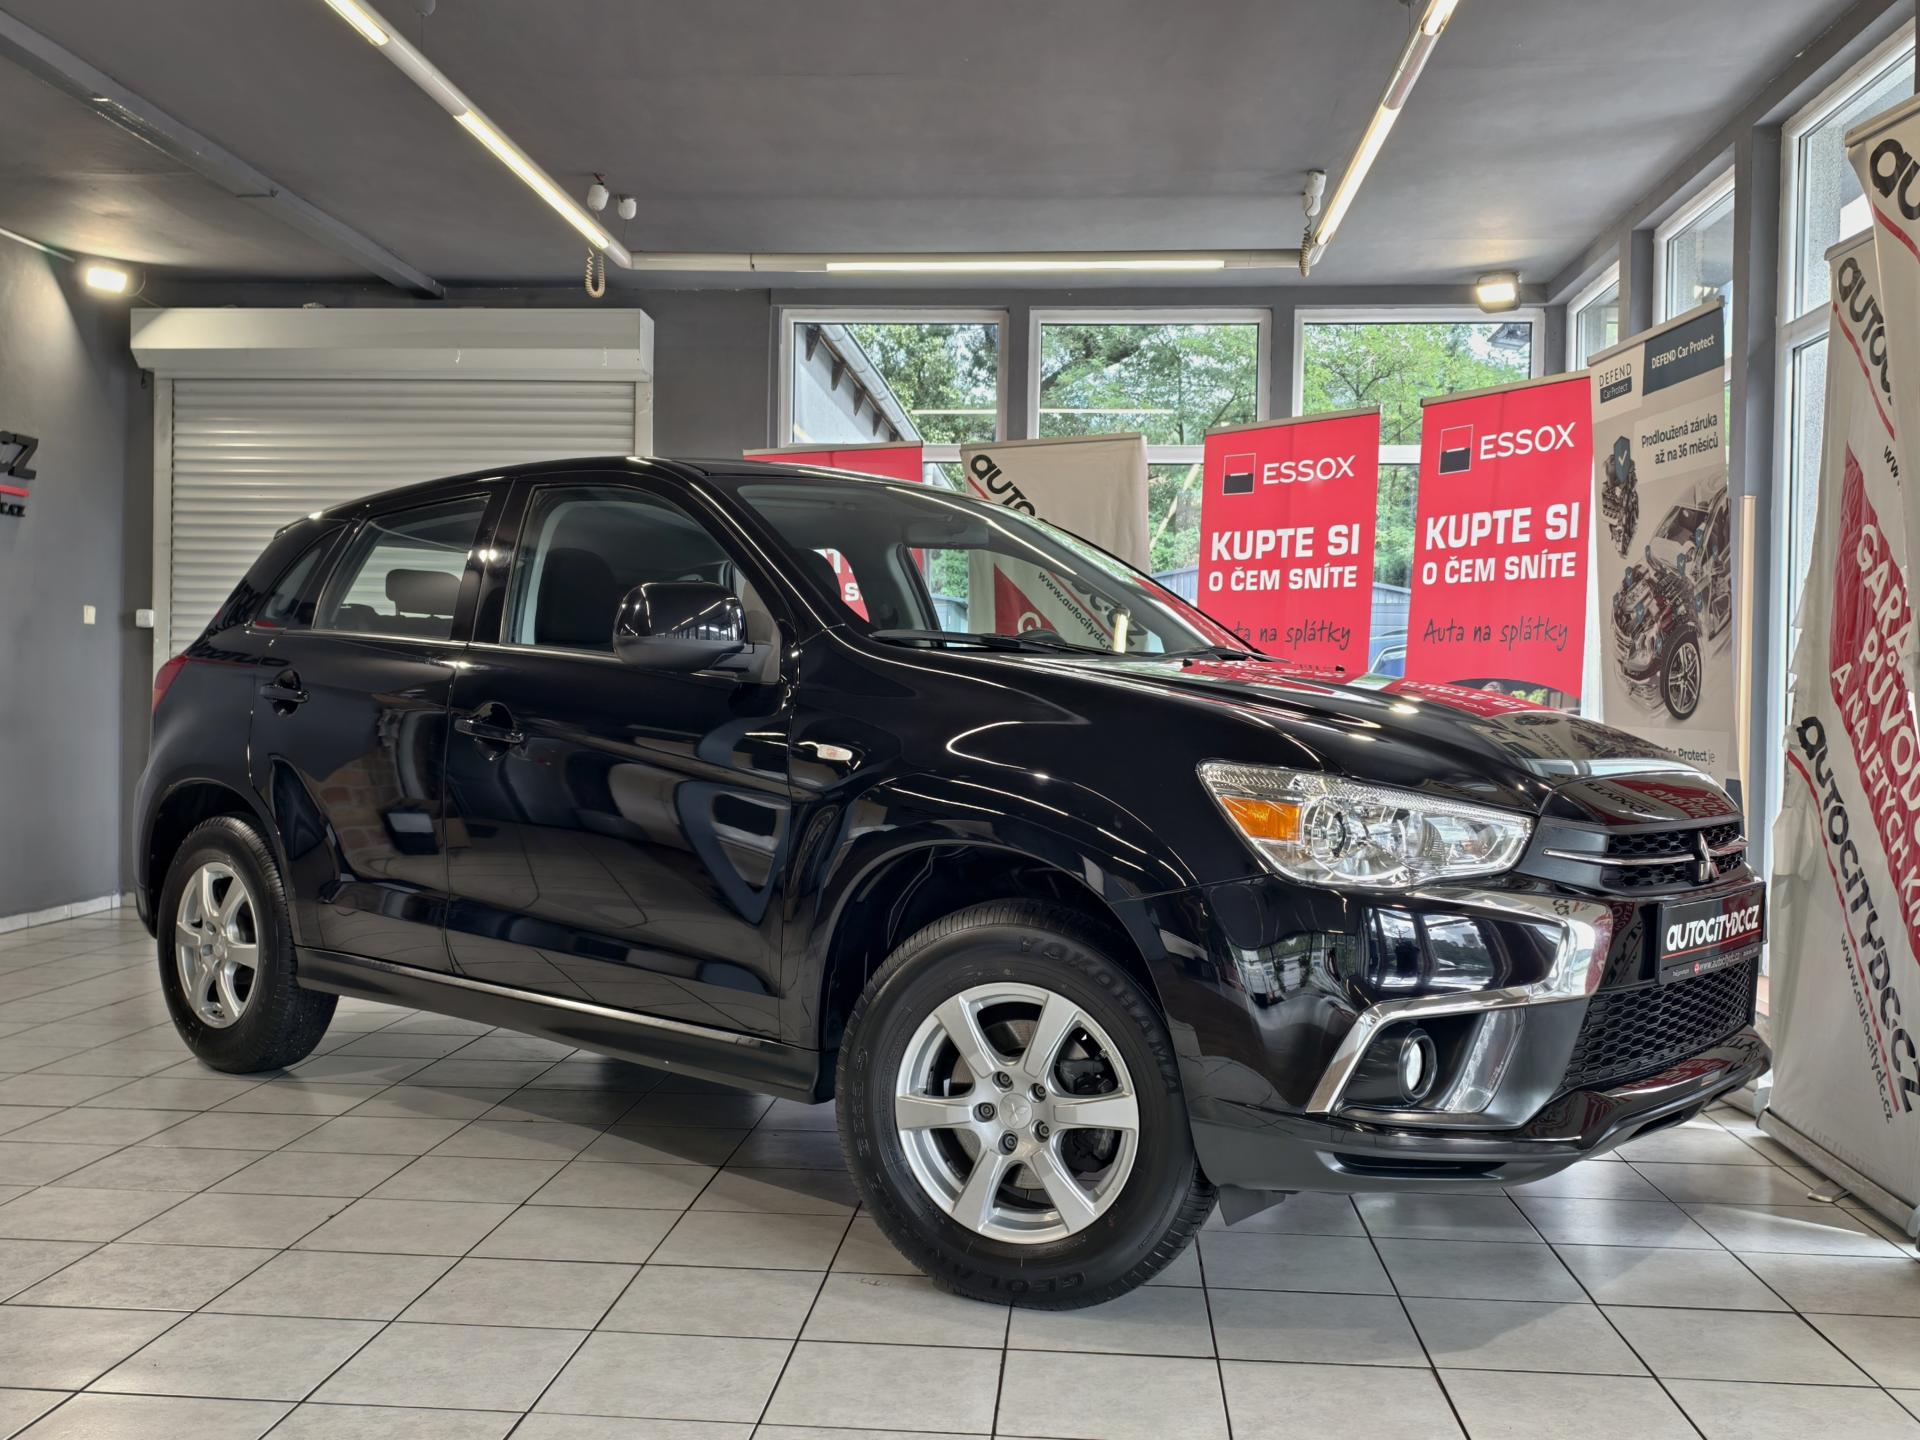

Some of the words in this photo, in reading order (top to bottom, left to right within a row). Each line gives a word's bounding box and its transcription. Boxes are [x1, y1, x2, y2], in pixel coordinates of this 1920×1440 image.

[1651, 349, 1677, 369] DEFEND
[1677, 346, 1689, 359] Car
[1689, 334, 1716, 354] Protect
[1599, 362, 1632, 387] DEFEND
[1480, 422, 1576, 461] ESSOX
[1641, 422, 1690, 448] Prodloužená
[1690, 413, 1718, 433] záruka
[1655, 449, 1666, 465] až
[1667, 449, 1678, 462] na
[1678, 444, 1688, 458] 36
[1689, 432, 1719, 456] měsíců
[1263, 455, 1357, 485] ESSOX
[1211, 527, 1315, 561] KUPTE
[1327, 523, 1361, 555] SI
[1425, 507, 1532, 550] KUPTE
[1545, 502, 1581, 541] SI
[1209, 571, 1224, 592] O
[1230, 564, 1281, 592] ČEM
[1289, 563, 1358, 590] SNÍTE
[1422, 561, 1438, 585] O
[1444, 555, 1496, 584] ČEM
[1504, 549, 1577, 580] SNÍTE
[1260, 627, 1278, 643] na
[1285, 618, 1351, 651] splátky
[1424, 618, 1464, 643] Auta
[1473, 626, 1491, 642] na
[1500, 615, 1568, 651] splátky
[1832, 662, 1852, 695] A
[1678, 748, 1708, 762] Protect
[1708, 749, 1716, 765] je
[1841, 932, 1893, 1124] www.autocitydc.cz
